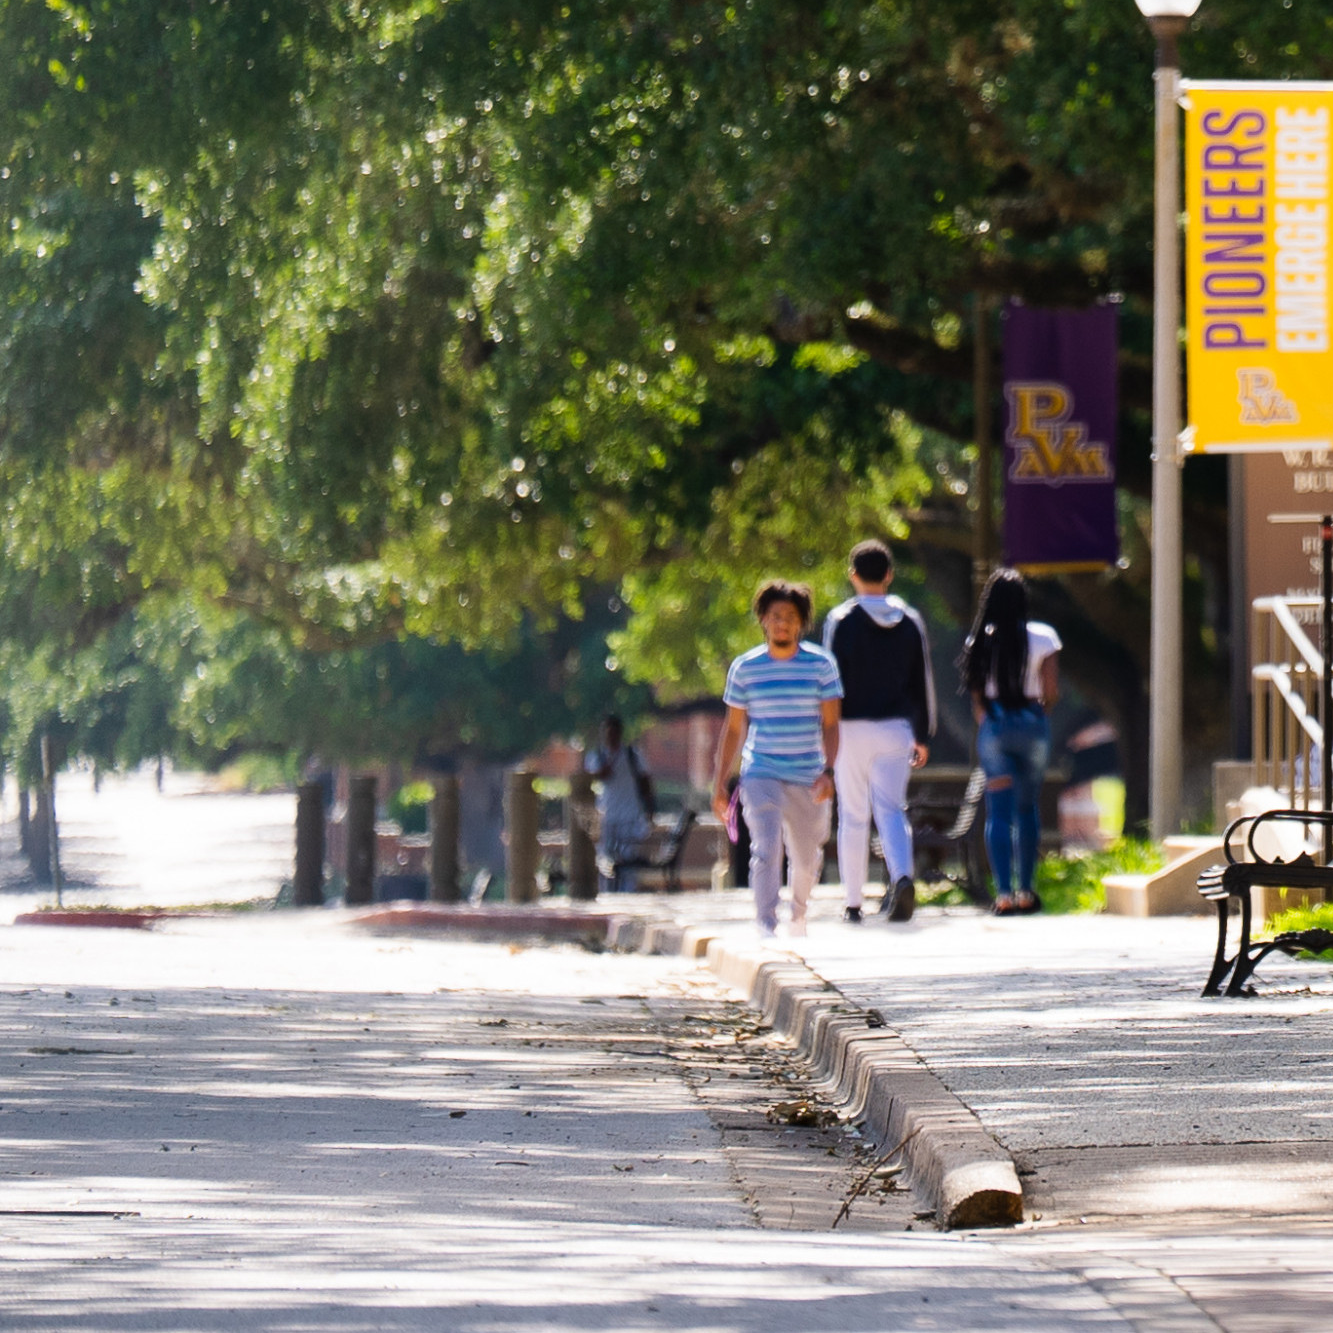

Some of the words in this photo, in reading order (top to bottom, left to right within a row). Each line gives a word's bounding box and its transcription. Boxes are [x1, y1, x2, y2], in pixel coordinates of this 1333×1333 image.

[1275, 107, 1328, 198] HERE
[1203, 111, 1266, 350] PIONEERS
[1275, 203, 1328, 353] EMERGE
